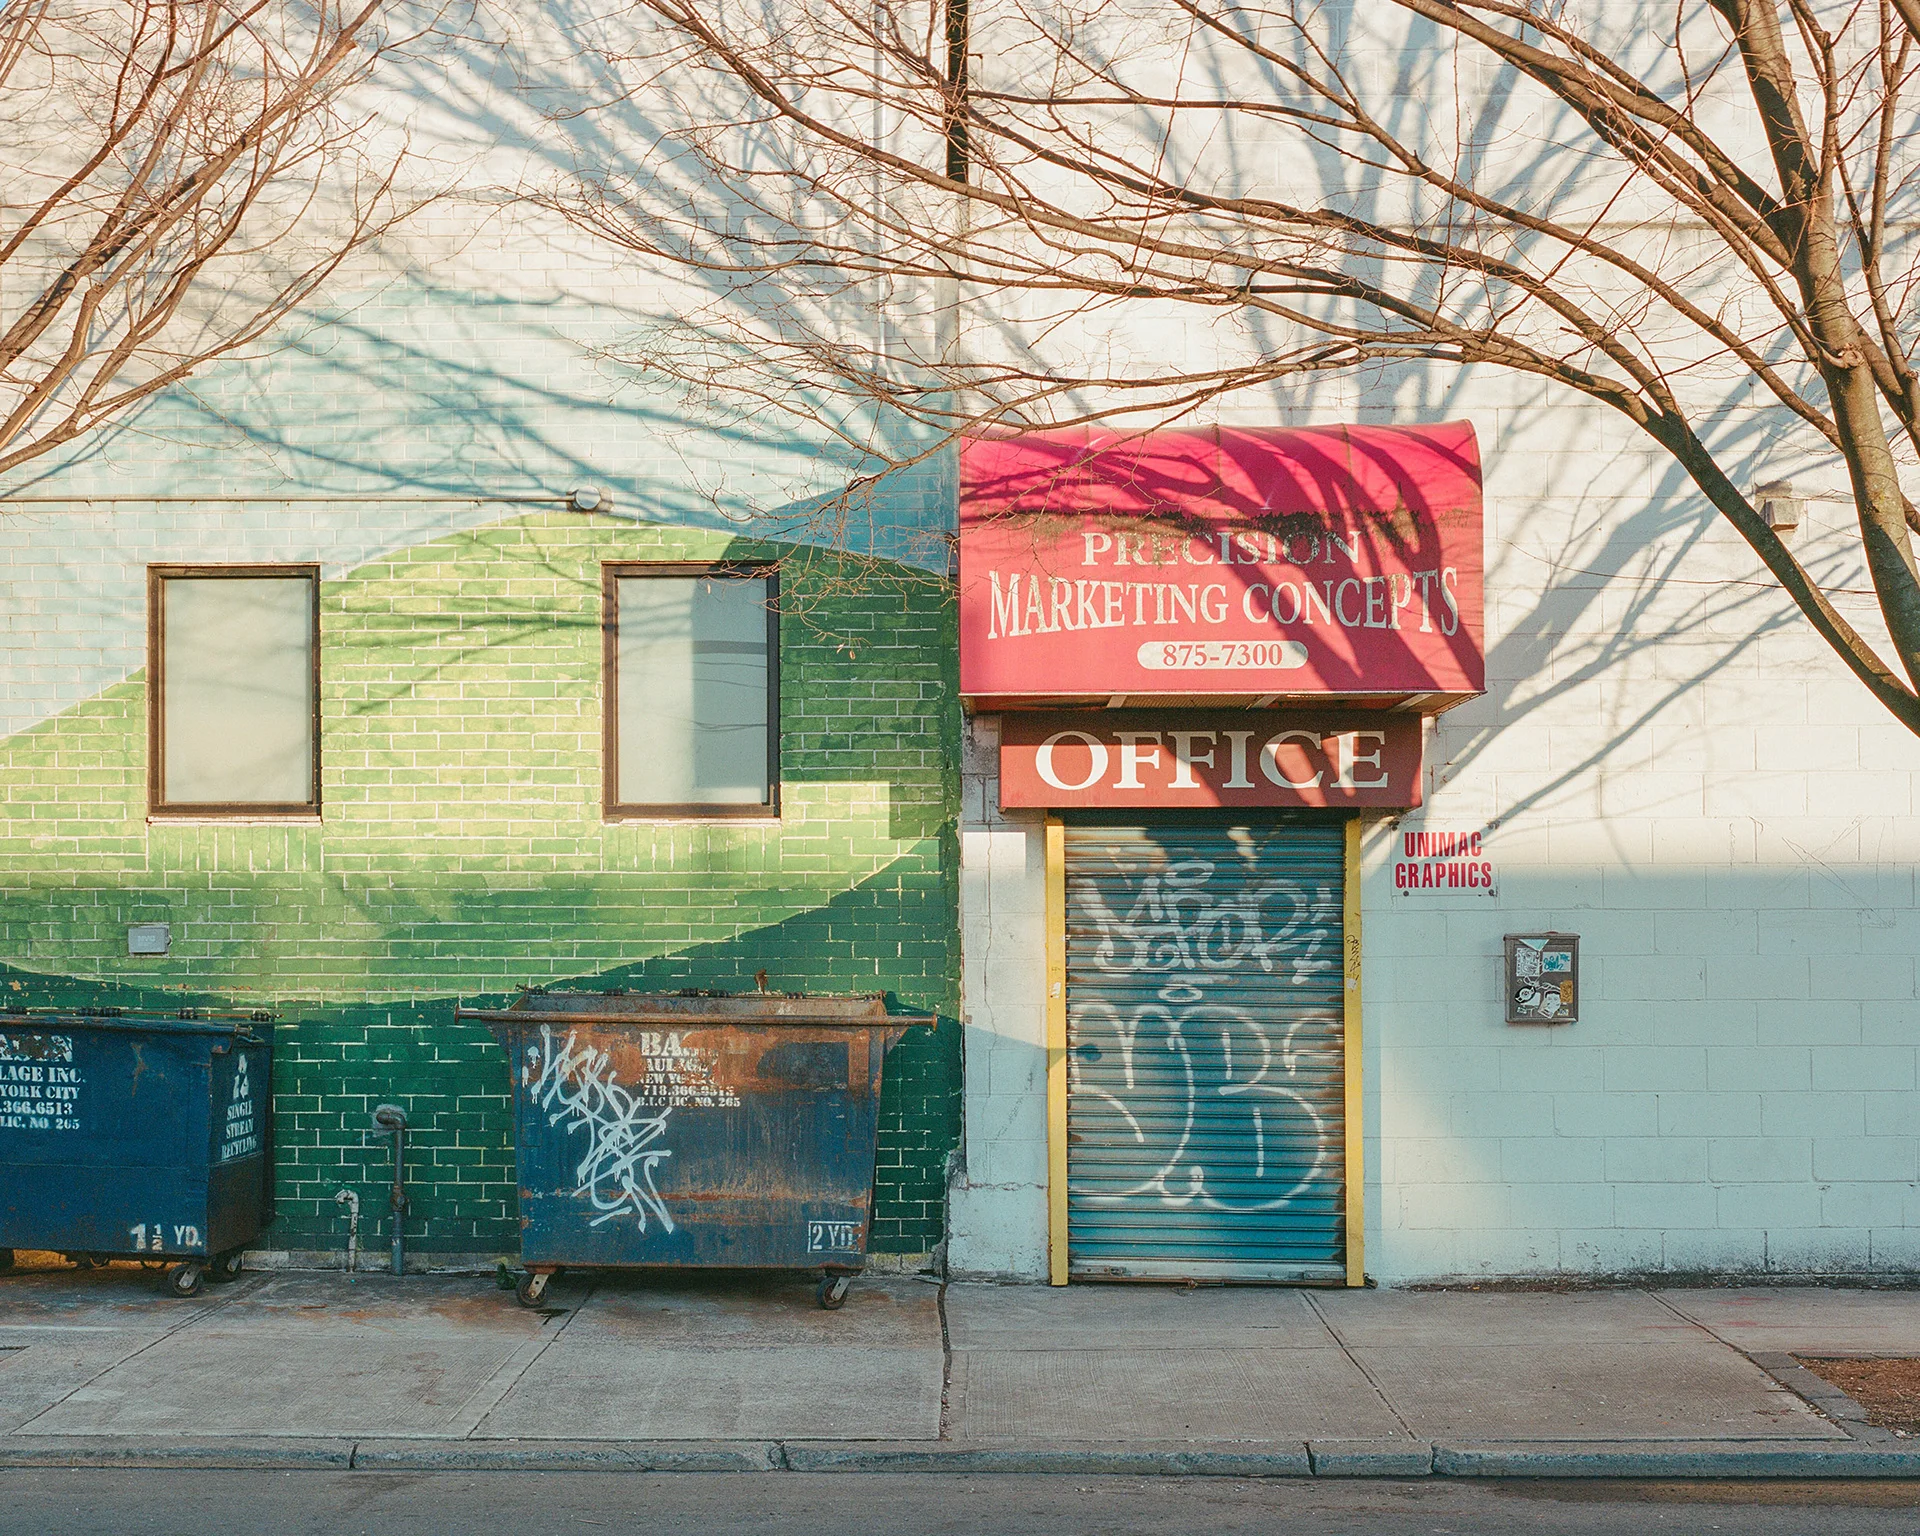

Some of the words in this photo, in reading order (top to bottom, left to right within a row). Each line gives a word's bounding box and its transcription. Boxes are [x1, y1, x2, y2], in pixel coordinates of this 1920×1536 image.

[1081, 530, 1361, 567] PRECISION
[988, 570, 1229, 640] MARKETING
[1243, 566, 1459, 637] CONCEPTS
[1162, 643, 1283, 667] 875-7300
[1034, 730, 1390, 790] OFFICE
[1404, 831, 1482, 858] UNIMAC
[1395, 862, 1492, 889] GRAPHICS
[0, 1085, 42, 1097] YORK
[46, 1085, 80, 1099] CITY
[718, 1096, 741, 1107] 265
[173, 1225, 202, 1247] YD.
[812, 1224, 823, 1250] 2
